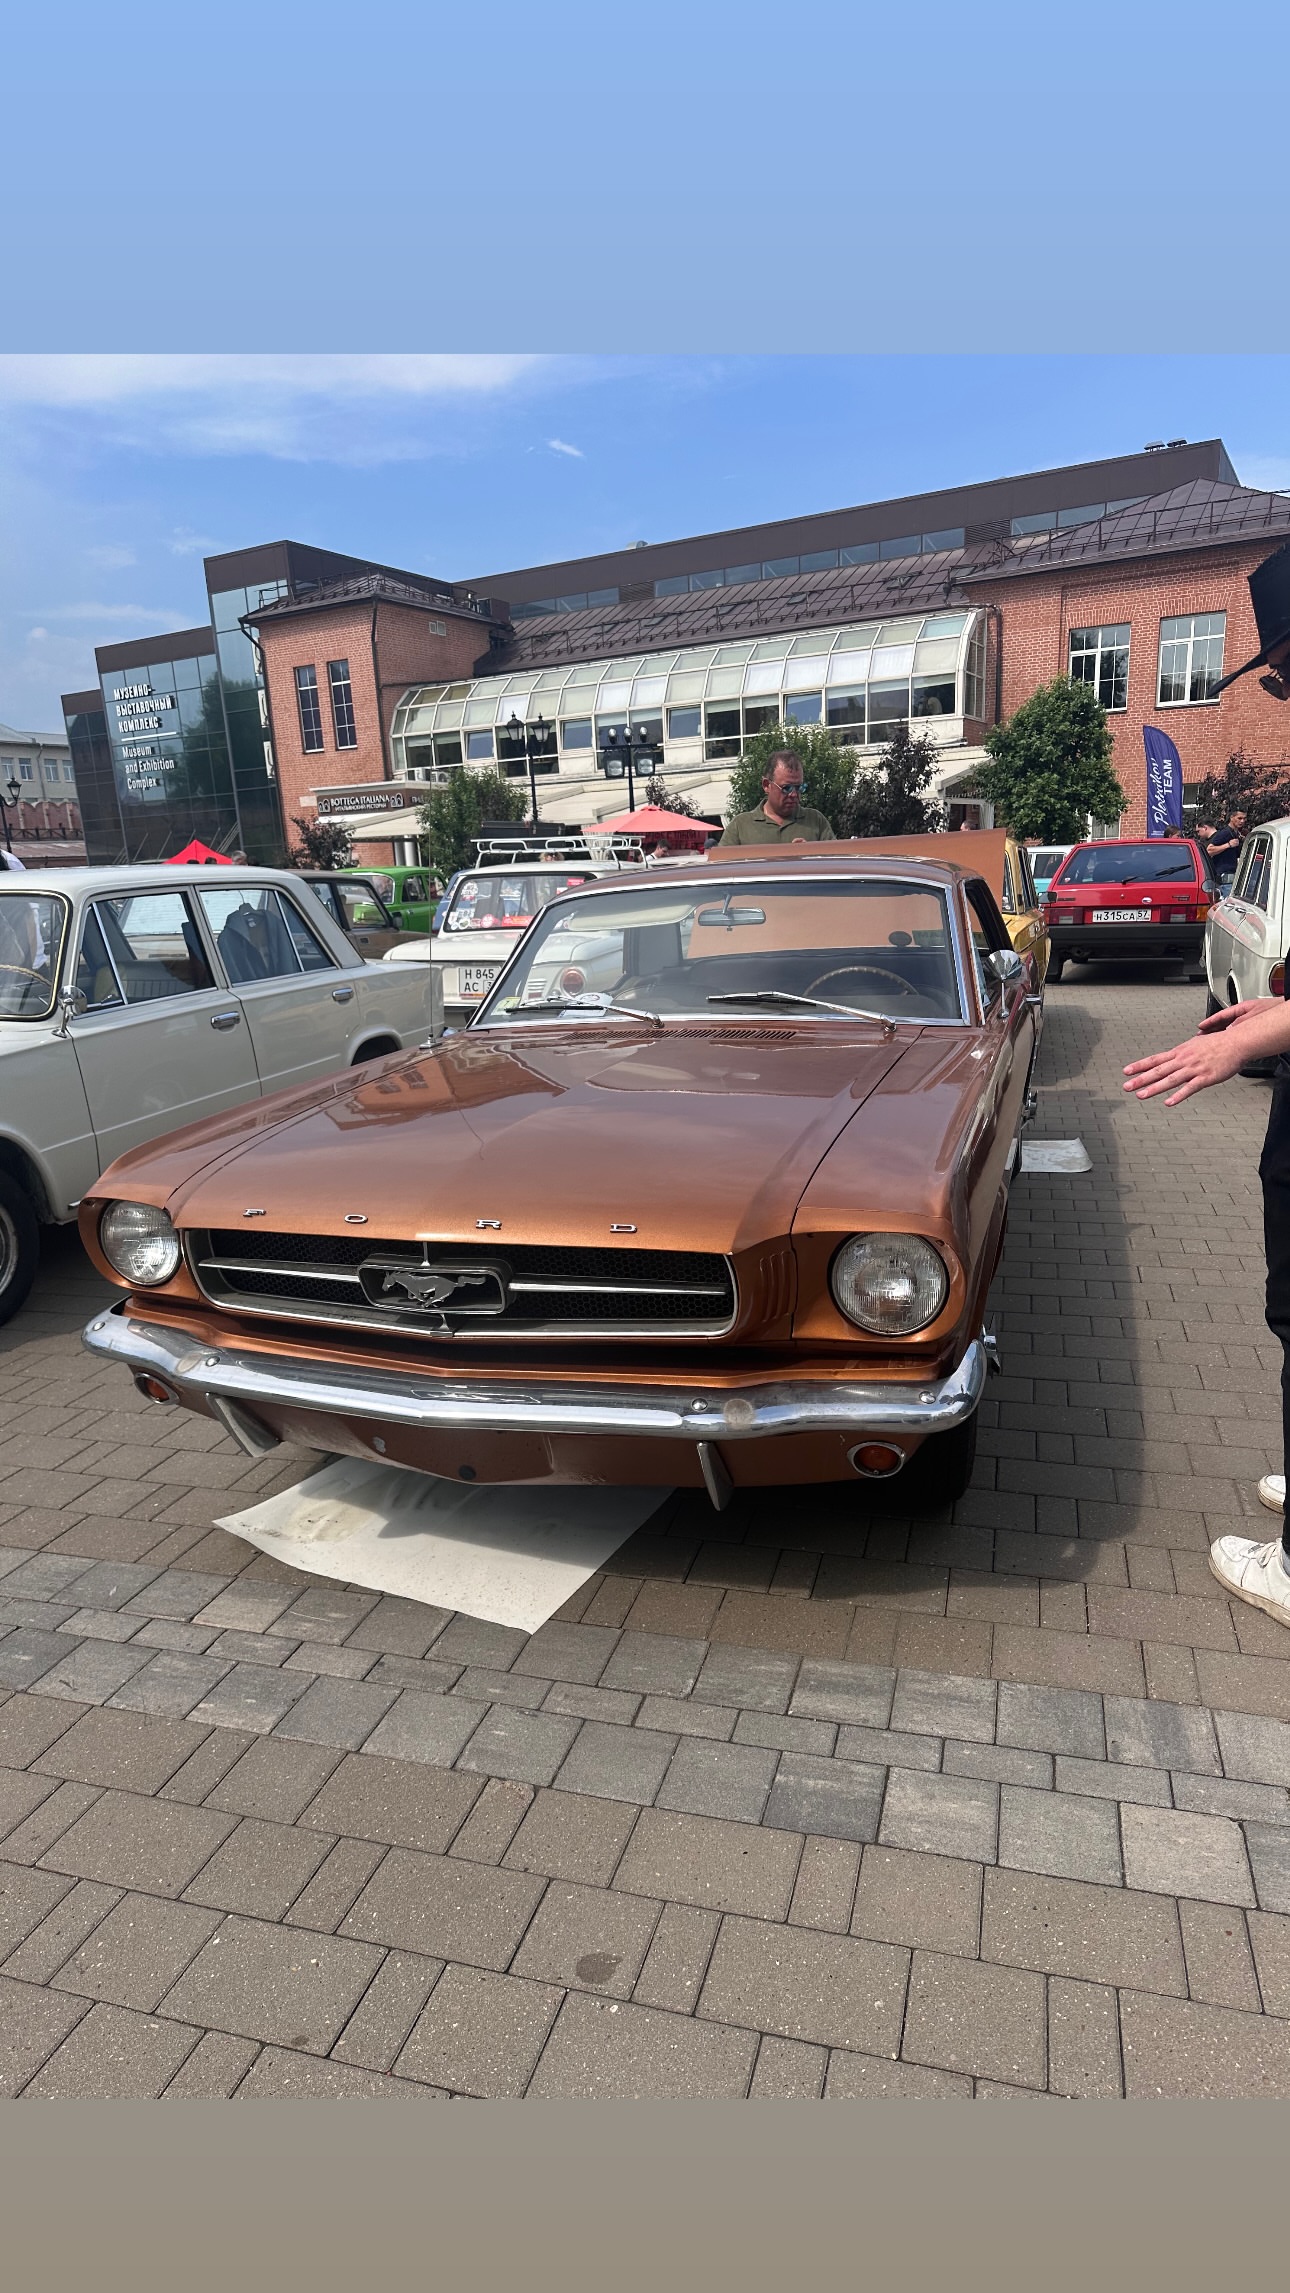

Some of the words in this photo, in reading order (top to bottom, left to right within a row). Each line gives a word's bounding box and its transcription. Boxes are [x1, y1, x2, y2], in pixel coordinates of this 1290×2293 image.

[116, 695, 172, 717] ВЫСТАВОЧНЫЙ
[118, 716, 160, 733] КОМПЛЕКС
[121, 745, 152, 758] Museum
[125, 762, 138, 774] and
[139, 758, 175, 773] Exhibition
[127, 777, 157, 791] Complex
[1163, 759, 1172, 795] TEAM
[331, 796, 360, 807] BOTTEGA
[361, 794, 390, 805] ITALIANA
[1138, 910, 1148, 918] 57
[475, 968, 495, 980] 845
[242, 1208, 638, 1234] FORD
